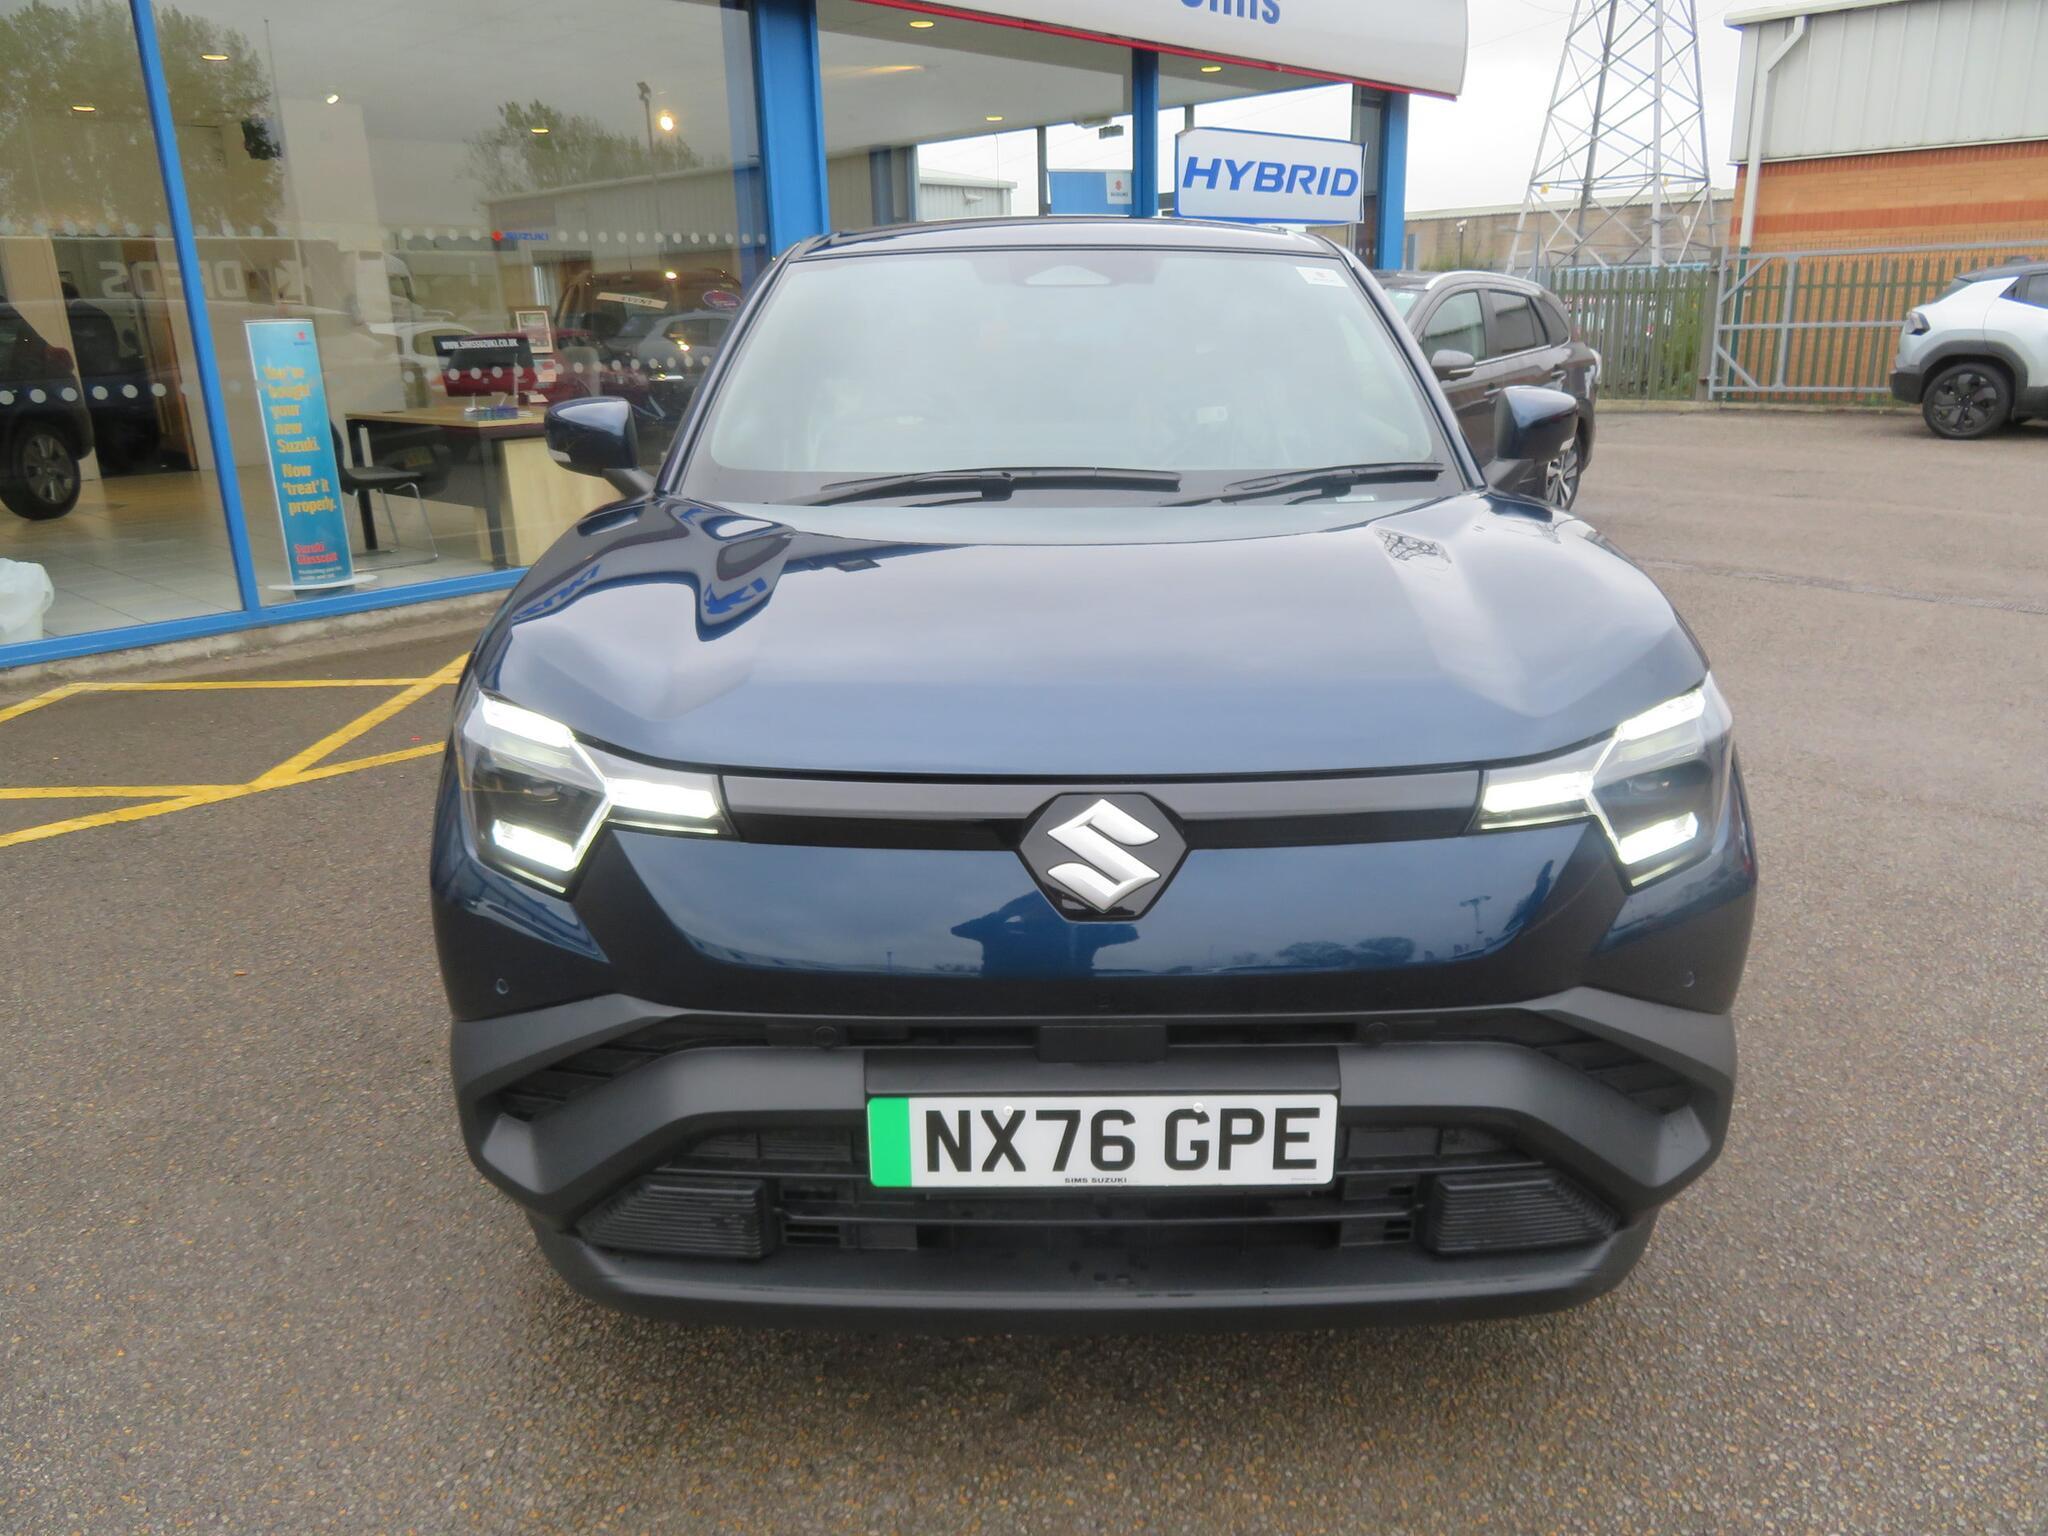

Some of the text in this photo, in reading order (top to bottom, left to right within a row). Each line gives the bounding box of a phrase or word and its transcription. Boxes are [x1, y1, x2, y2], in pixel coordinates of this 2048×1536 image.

[1182, 156, 1359, 197] HYBRID
[282, 463, 312, 478] Now
[926, 1107, 1320, 1172] NX76 GPE
